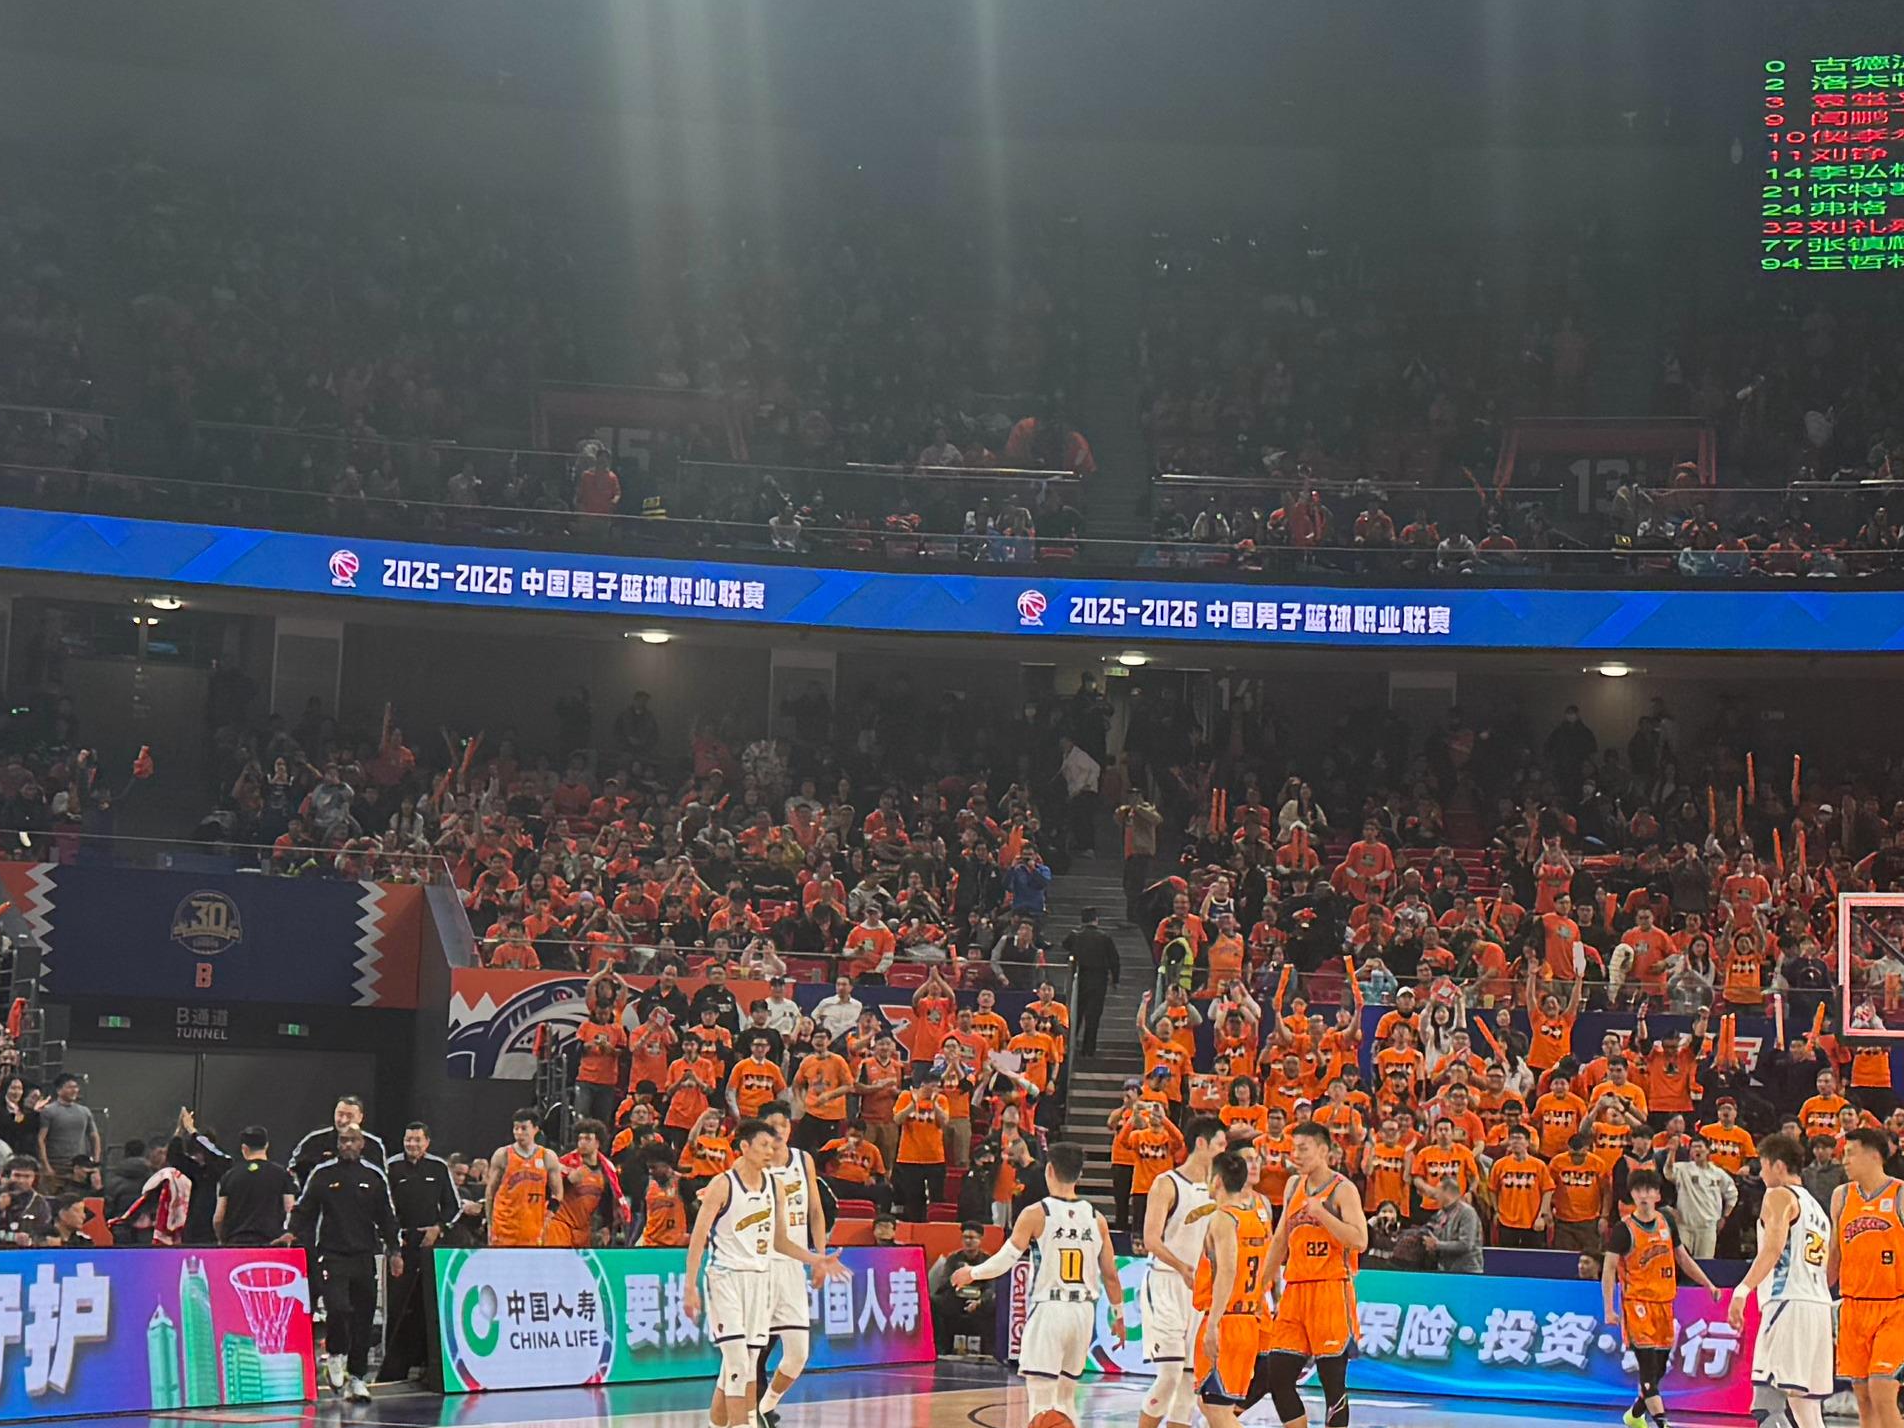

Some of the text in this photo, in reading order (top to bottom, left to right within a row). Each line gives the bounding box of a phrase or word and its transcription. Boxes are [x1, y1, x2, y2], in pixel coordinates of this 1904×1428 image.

[1765, 60, 1785, 72] 0
[1765, 78, 1785, 90] 2
[1765, 97, 1784, 108] 3
[1765, 114, 1784, 126] 9
[1767, 130, 1805, 144] 10
[1768, 149, 1802, 163] 11
[1765, 167, 1805, 180] 14
[1762, 185, 1800, 197] 21
[1762, 203, 1804, 216] 24
[1808, 199, 1887, 217] 弗格
[1763, 221, 1804, 234] 32
[1762, 239, 1804, 252] 77
[1760, 257, 1804, 270] 94
[382, 558, 766, 611] 2025-2026 中国男子篮球职业联赛
[1069, 595, 1451, 635] 2025-2026 中国男子篮球职业联赛
[190, 900, 228, 928] 30
[196, 963, 212, 988] B
[175, 1027, 228, 1041] TUNNEL
[1306, 1241, 1329, 1257] 32
[1058, 1248, 1085, 1284] 0
[1245, 1255, 1260, 1294] 3
[507, 1290, 597, 1324] 中国人寿
[510, 1329, 598, 1350] CHINA LIFE
[1357, 1301, 1741, 1379] 保险·投资·行
